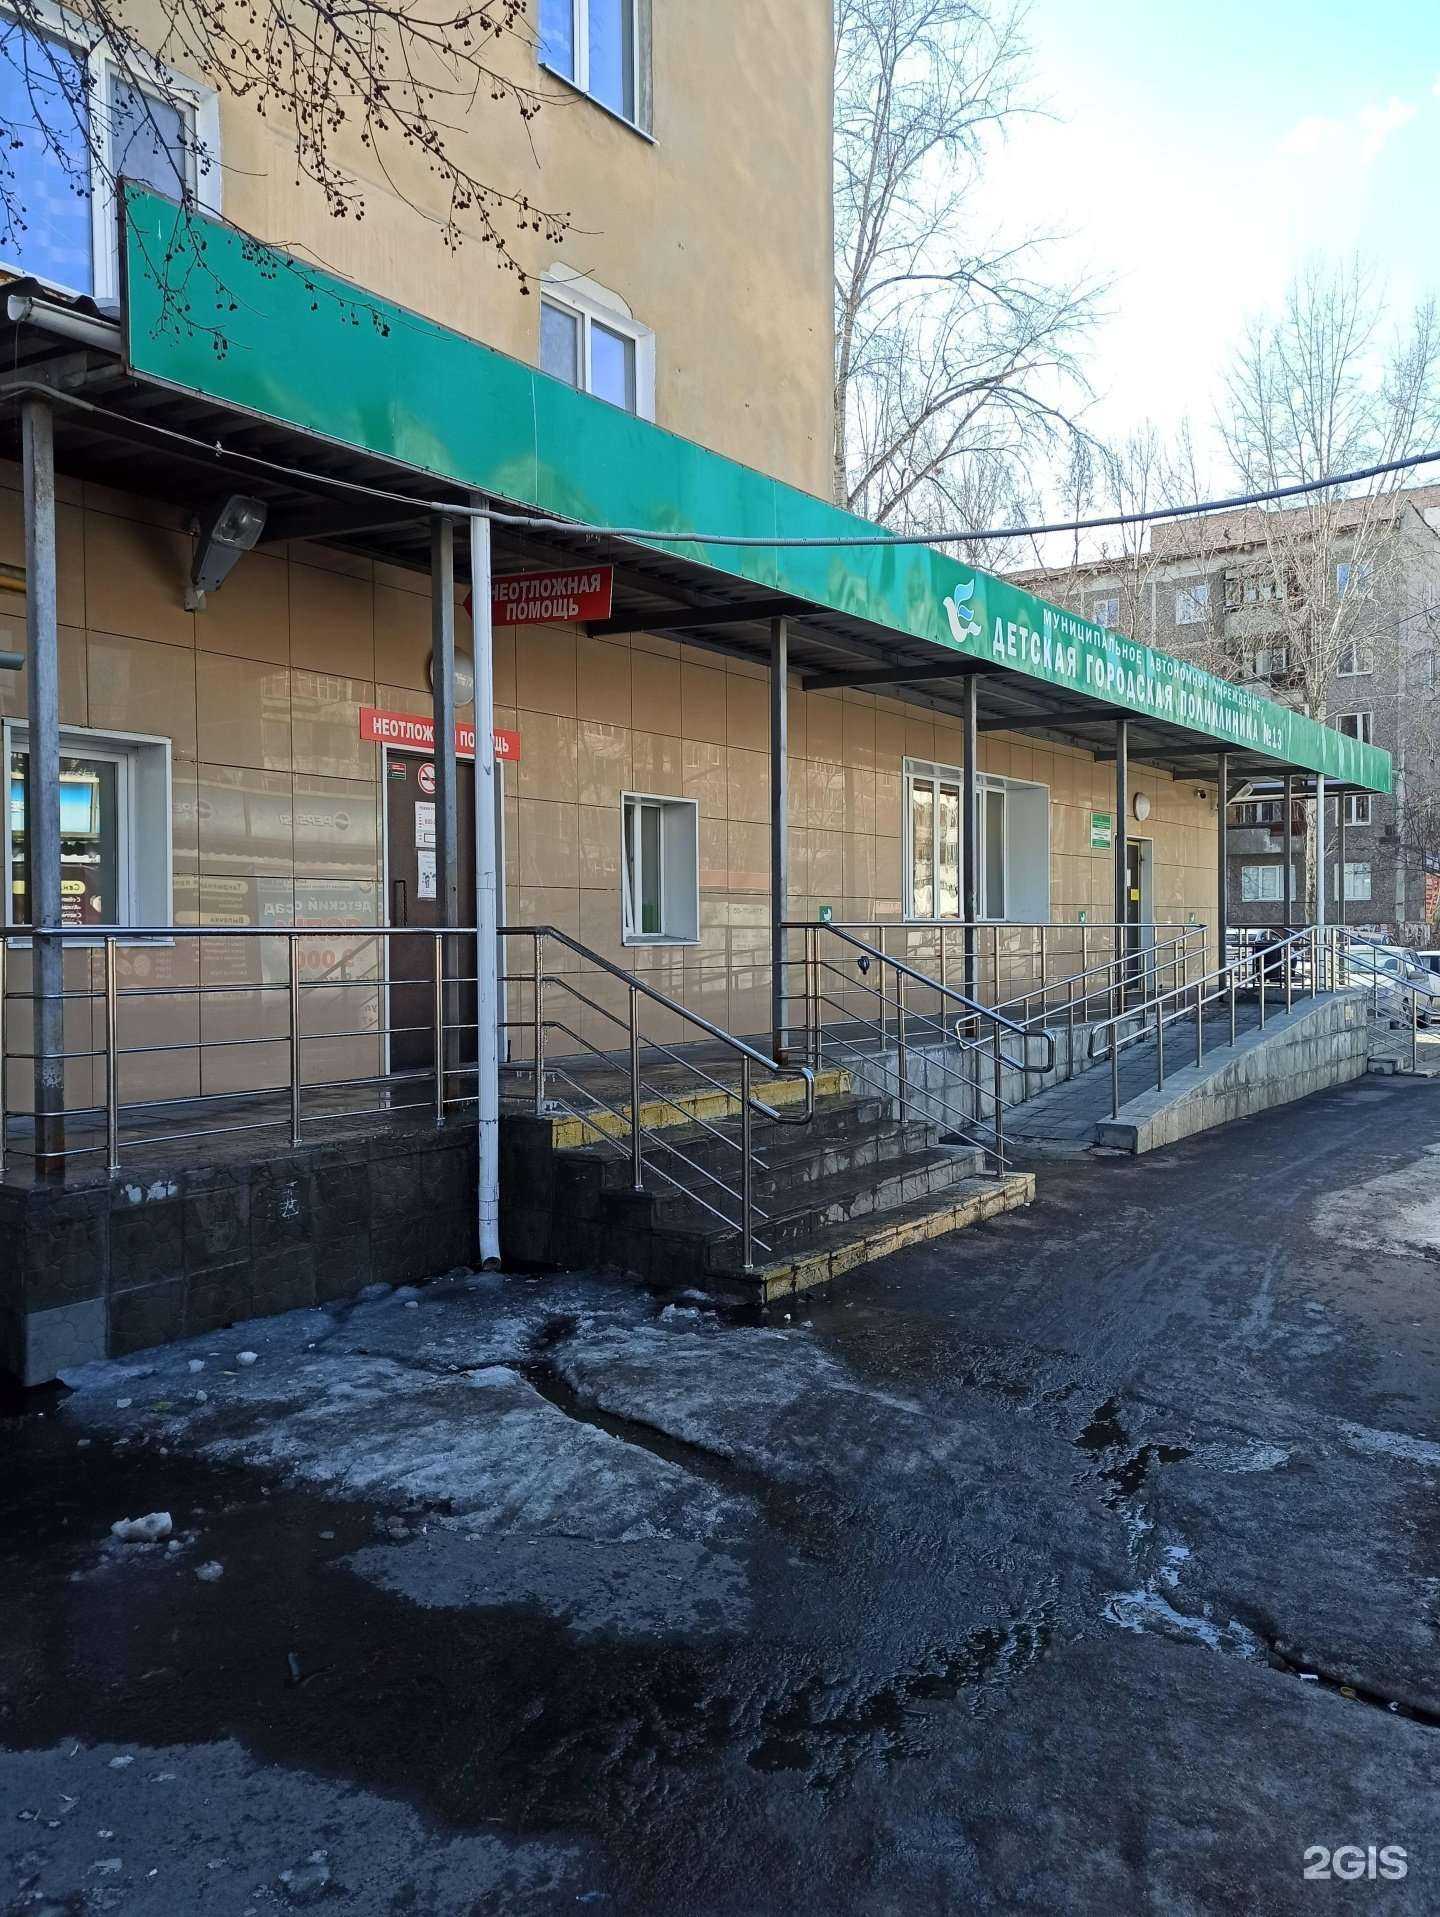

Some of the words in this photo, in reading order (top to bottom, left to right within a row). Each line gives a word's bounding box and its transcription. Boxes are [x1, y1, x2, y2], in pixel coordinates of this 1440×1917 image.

[506, 598, 579, 621] ПОМОЩЬ
[1043, 608, 1142, 665] МУНИЦИПАЛЬНОЕ
[1150, 655, 1208, 690] АВТОНОМНОЕ
[993, 616, 1076, 679] ДЕТСКАЯ
[1086, 653, 1174, 713] ГОРОДСКАЯ
[1180, 690, 1258, 742] ПОЛИКЛИНИКА
[1263, 721, 1283, 751] №13
[460, 731, 510, 755] ПОЩЬ
